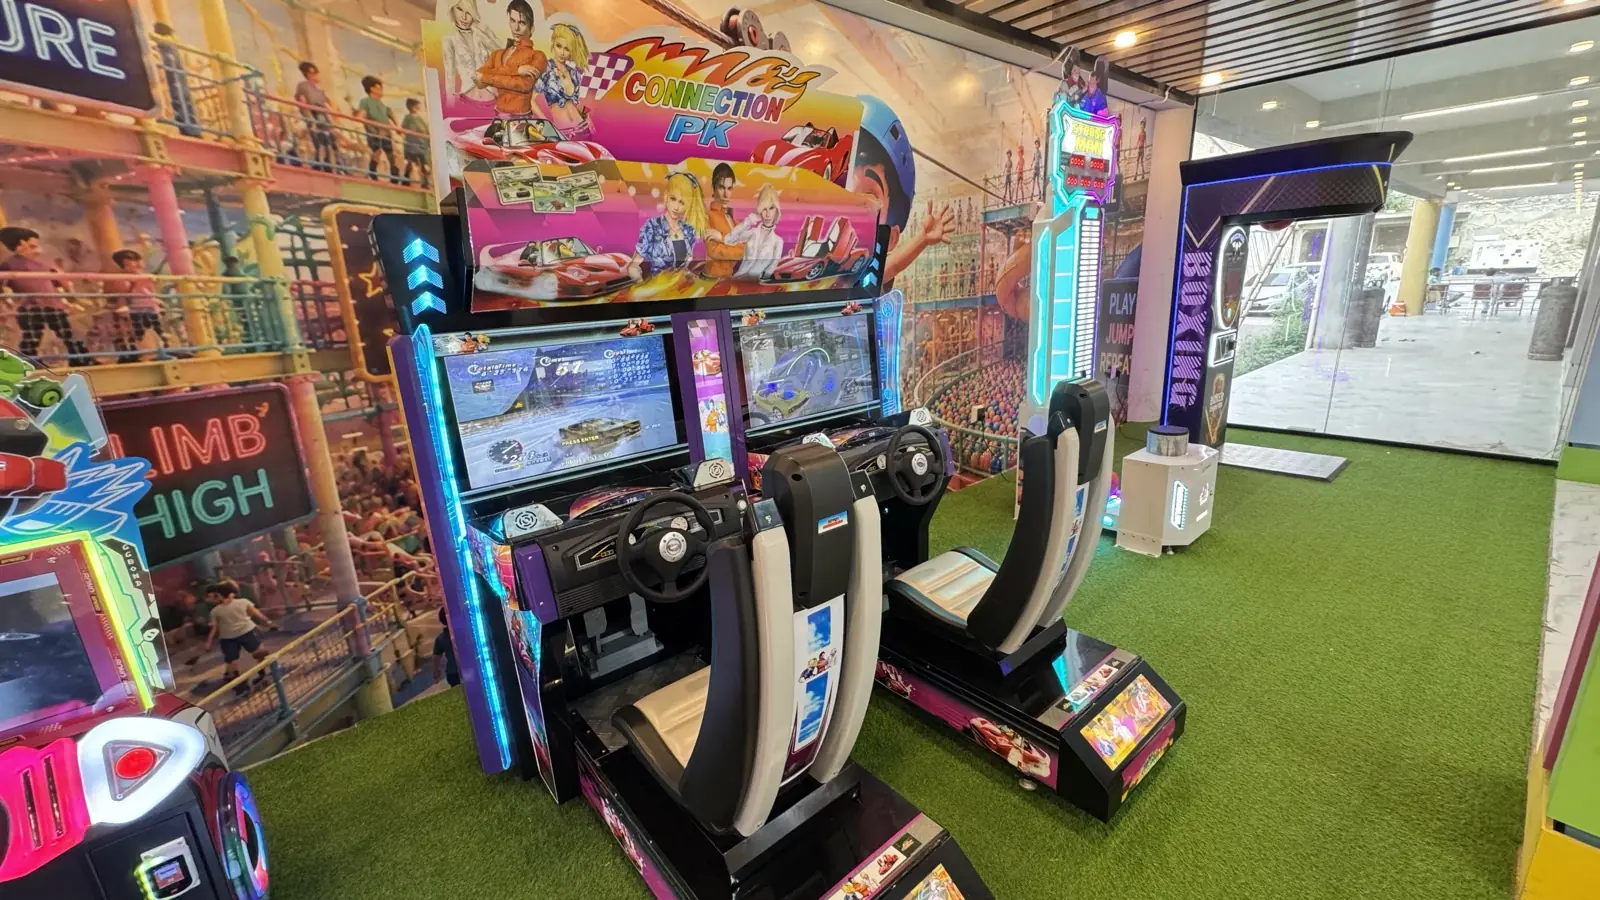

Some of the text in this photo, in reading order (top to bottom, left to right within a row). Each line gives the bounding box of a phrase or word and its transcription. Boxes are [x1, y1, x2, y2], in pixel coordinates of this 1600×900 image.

[625, 72, 785, 122] CONNECTION
[665, 113, 737, 148] PK
[1109, 292, 1137, 315] PLAY
[1106, 322, 1134, 345] JUMP
[1169, 252, 1213, 407] BOXING
[1100, 352, 1132, 375] REPEA
[581, 435, 600, 443] ENTER
[138, 468, 274, 539] HIGH
